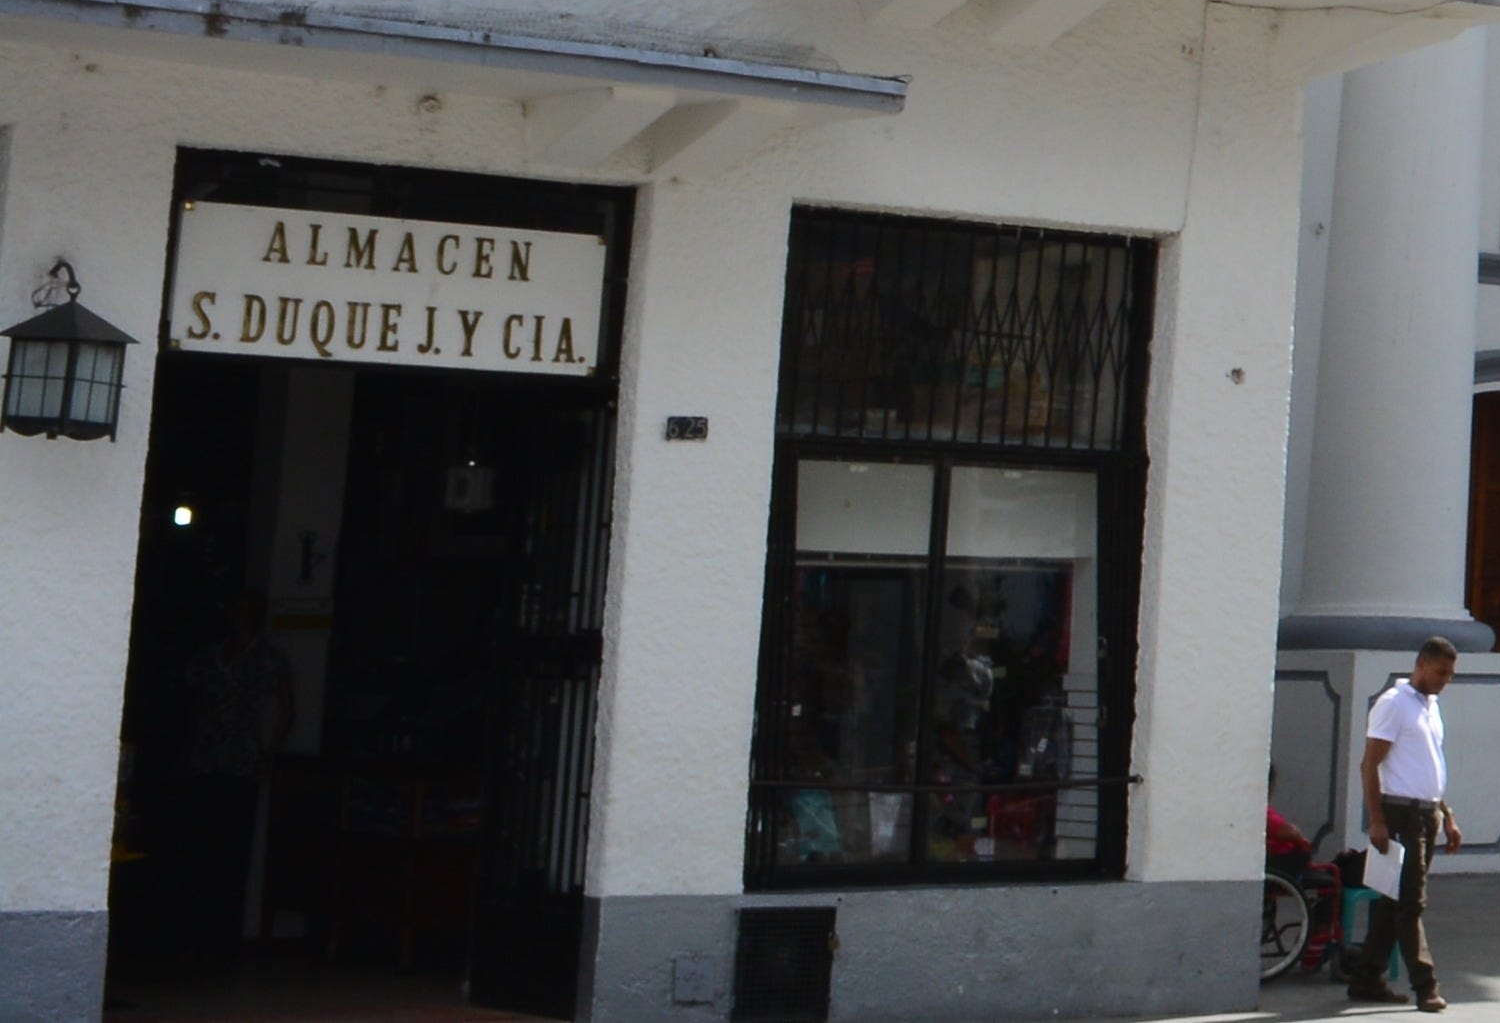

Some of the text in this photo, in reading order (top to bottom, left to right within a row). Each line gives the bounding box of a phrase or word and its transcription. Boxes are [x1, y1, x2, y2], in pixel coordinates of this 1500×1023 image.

[262, 221, 533, 282] ALMACEN
[188, 291, 586, 364] S. DUQUE J. Y CIA.
